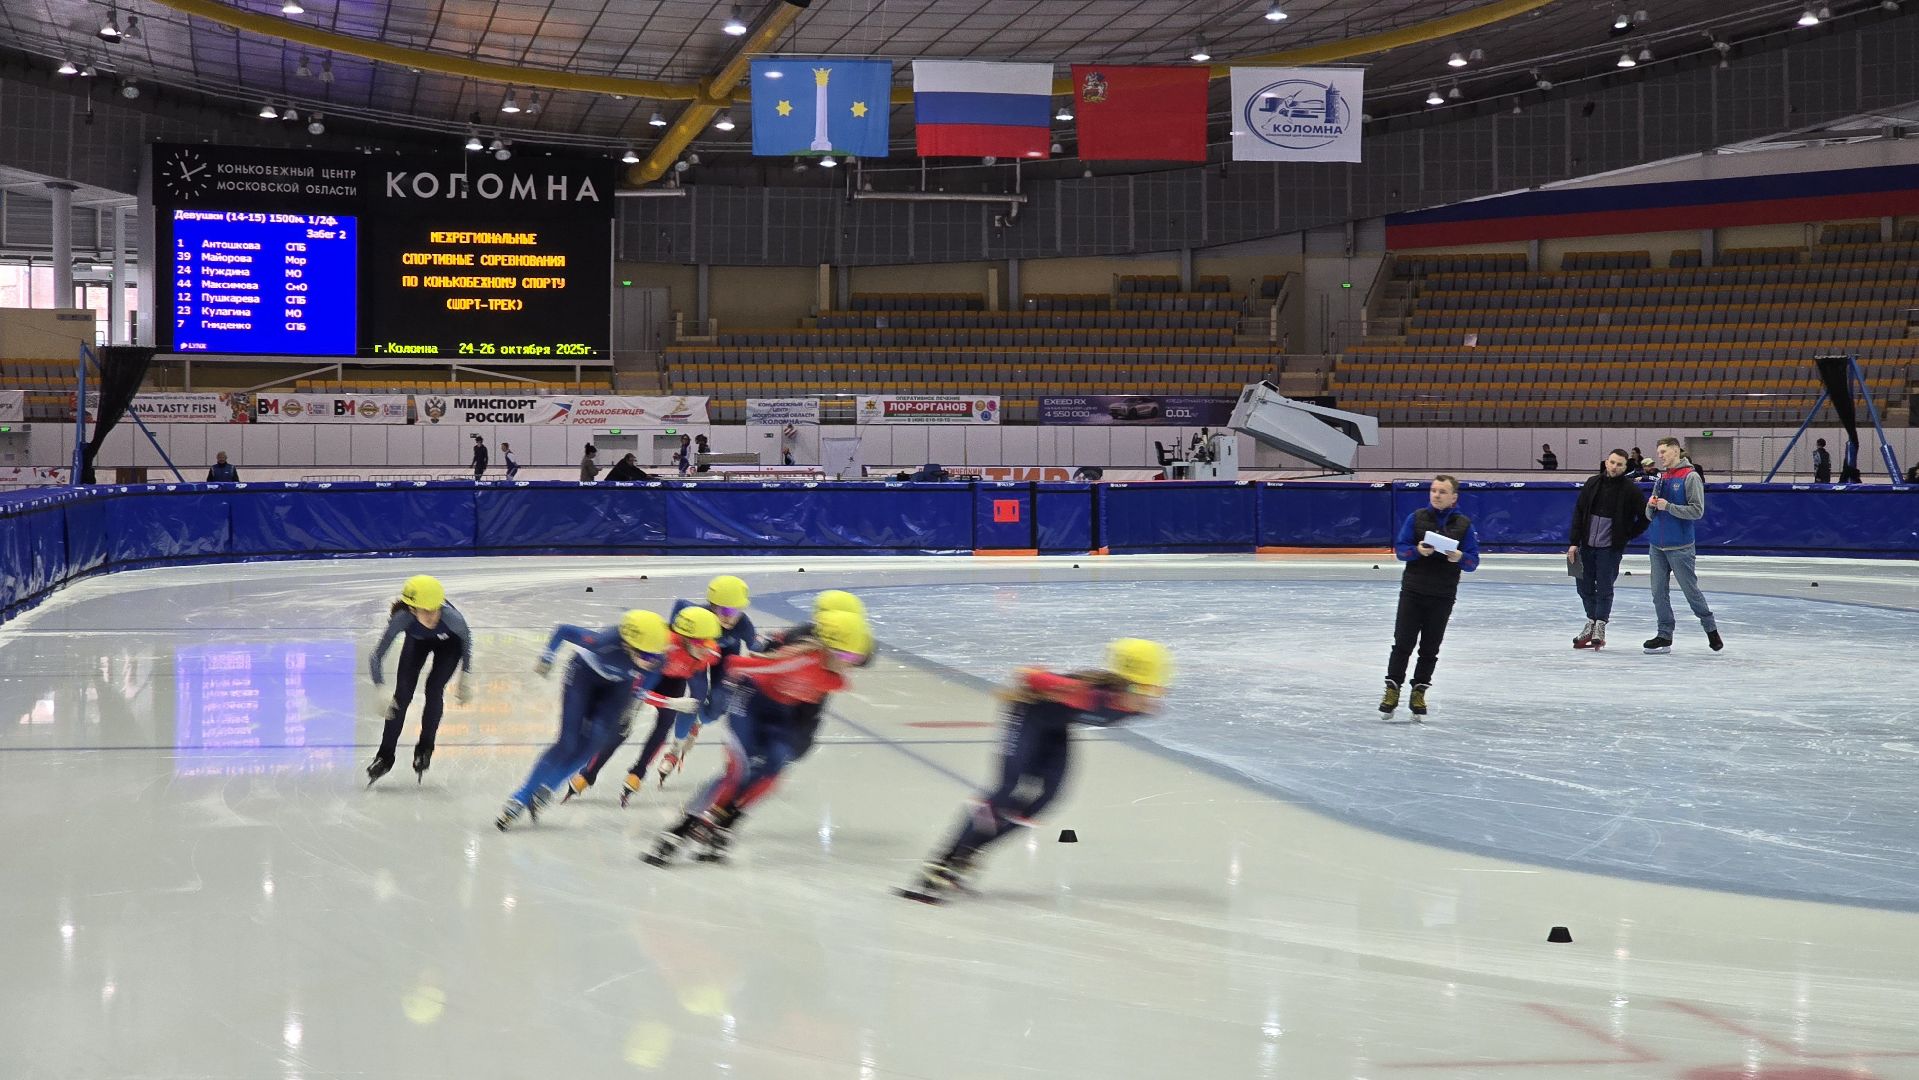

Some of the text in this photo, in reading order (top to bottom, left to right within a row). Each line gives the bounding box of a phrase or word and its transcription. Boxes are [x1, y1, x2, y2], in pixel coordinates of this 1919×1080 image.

[1273, 124, 1342, 134] КОЛОМНА
[217, 163, 356, 180] КОНЬКОБЕЖНЫЙ ЦЕНТР
[217, 180, 357, 196] МОСКОВСКОЙ ОБЛАСТИ
[386, 171, 600, 202] КОЛОМНА
[174, 210, 224, 221] Девушки
[226, 212, 266, 223] (14-15)
[306, 229, 346, 239] Забег 2
[177, 239, 306, 252] 1 Антошкова СПБ
[177, 252, 306, 266] 39 Майорова Мор
[402, 254, 566, 266] СПОРТИВНЫЕ СОРЕВНОВАНИЯ
[177, 266, 302, 278] 24 Нуждина МО
[177, 279, 308, 291] 44 Максимова СмО
[402, 276, 566, 289] ПО КОНЬКОБЕЖНОМУ СПОРТУ
[177, 293, 306, 305] 12 Пушкарева СПБ
[446, 299, 523, 311] (ШОРТ-ТРЕК)
[177, 306, 302, 318] 23 Кулагина МО
[177, 320, 306, 331] 7 Гниденко СПБ
[374, 342, 597, 355] г.Коломна 24-26 октября 2025г.
[157, 404, 189, 412] TASTY
[193, 404, 216, 413] FISH
[454, 398, 537, 410] МИНСПОРТ
[889, 402, 967, 411] ЛОР-ОРГАНОВ
[465, 412, 525, 423] РОССИИ
[576, 408, 645, 416] КОНЬКОБЕЖЦЕВ
[985, 468, 1070, 481] ТИР
